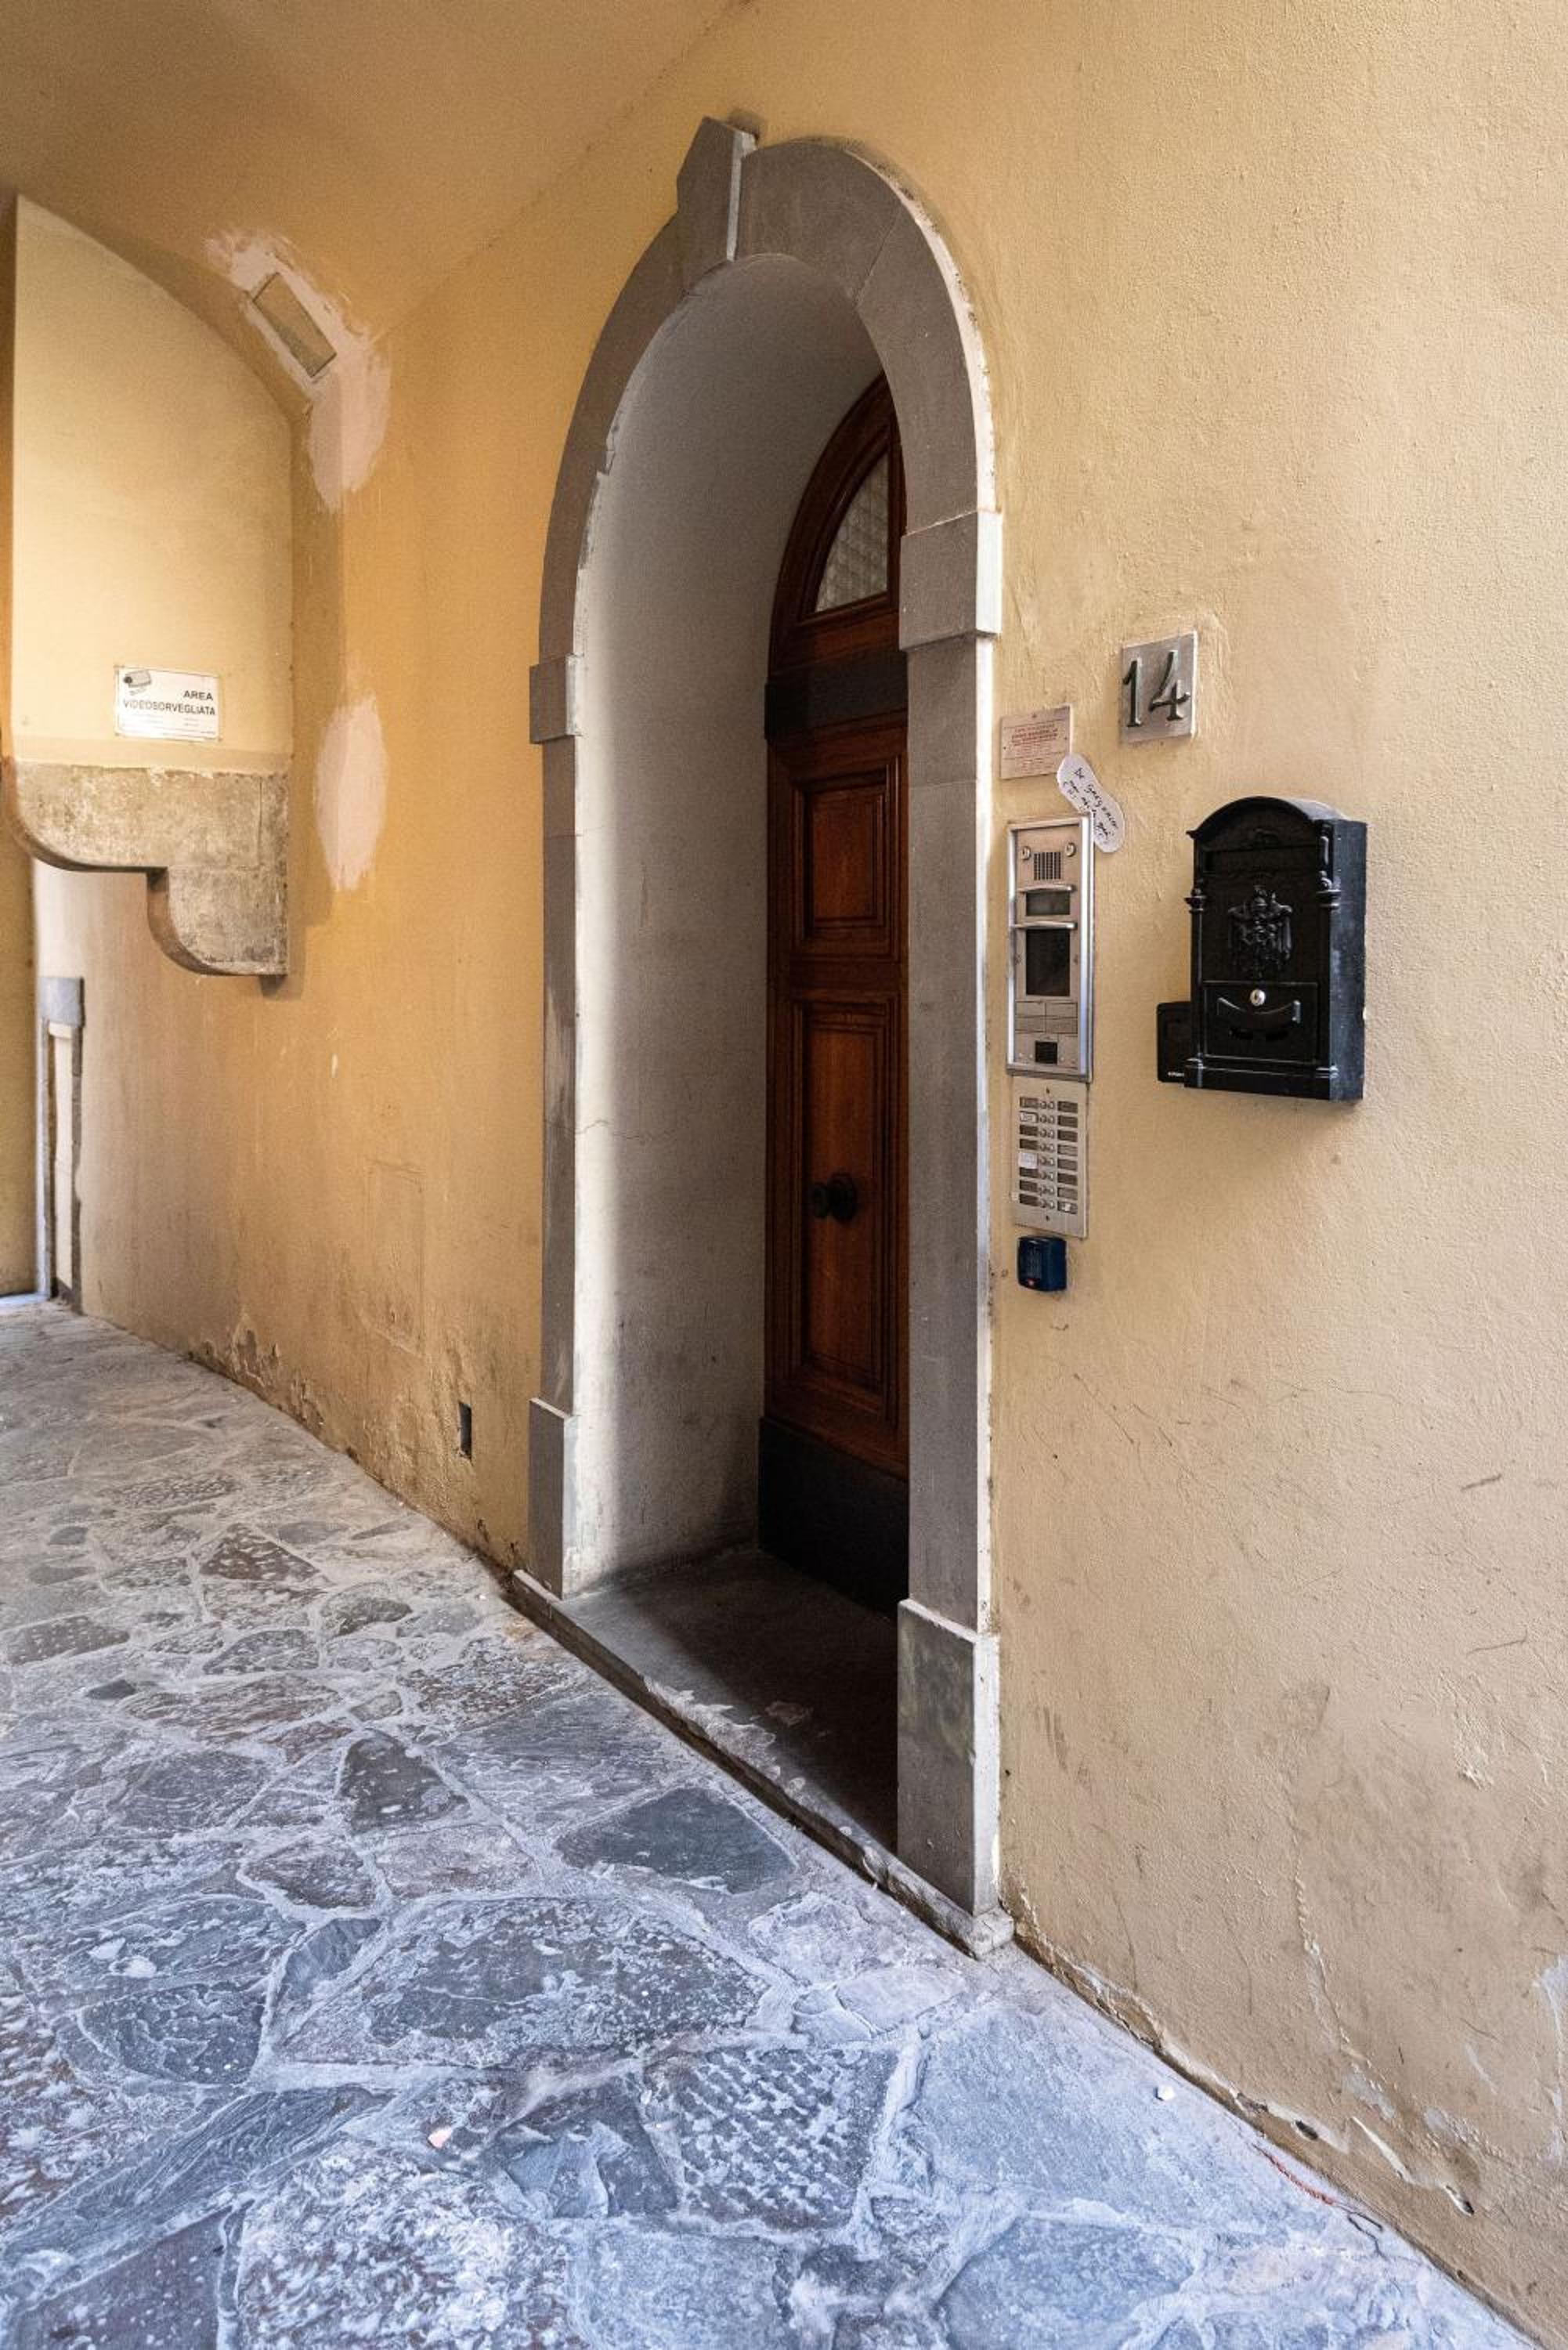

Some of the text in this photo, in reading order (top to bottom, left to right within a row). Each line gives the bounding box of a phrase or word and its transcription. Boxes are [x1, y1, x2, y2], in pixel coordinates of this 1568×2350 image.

[183, 690, 214, 701] AREA
[1122, 649, 1190, 727] 14
[123, 698, 216, 715] VIDEOSORVEGLIATA
